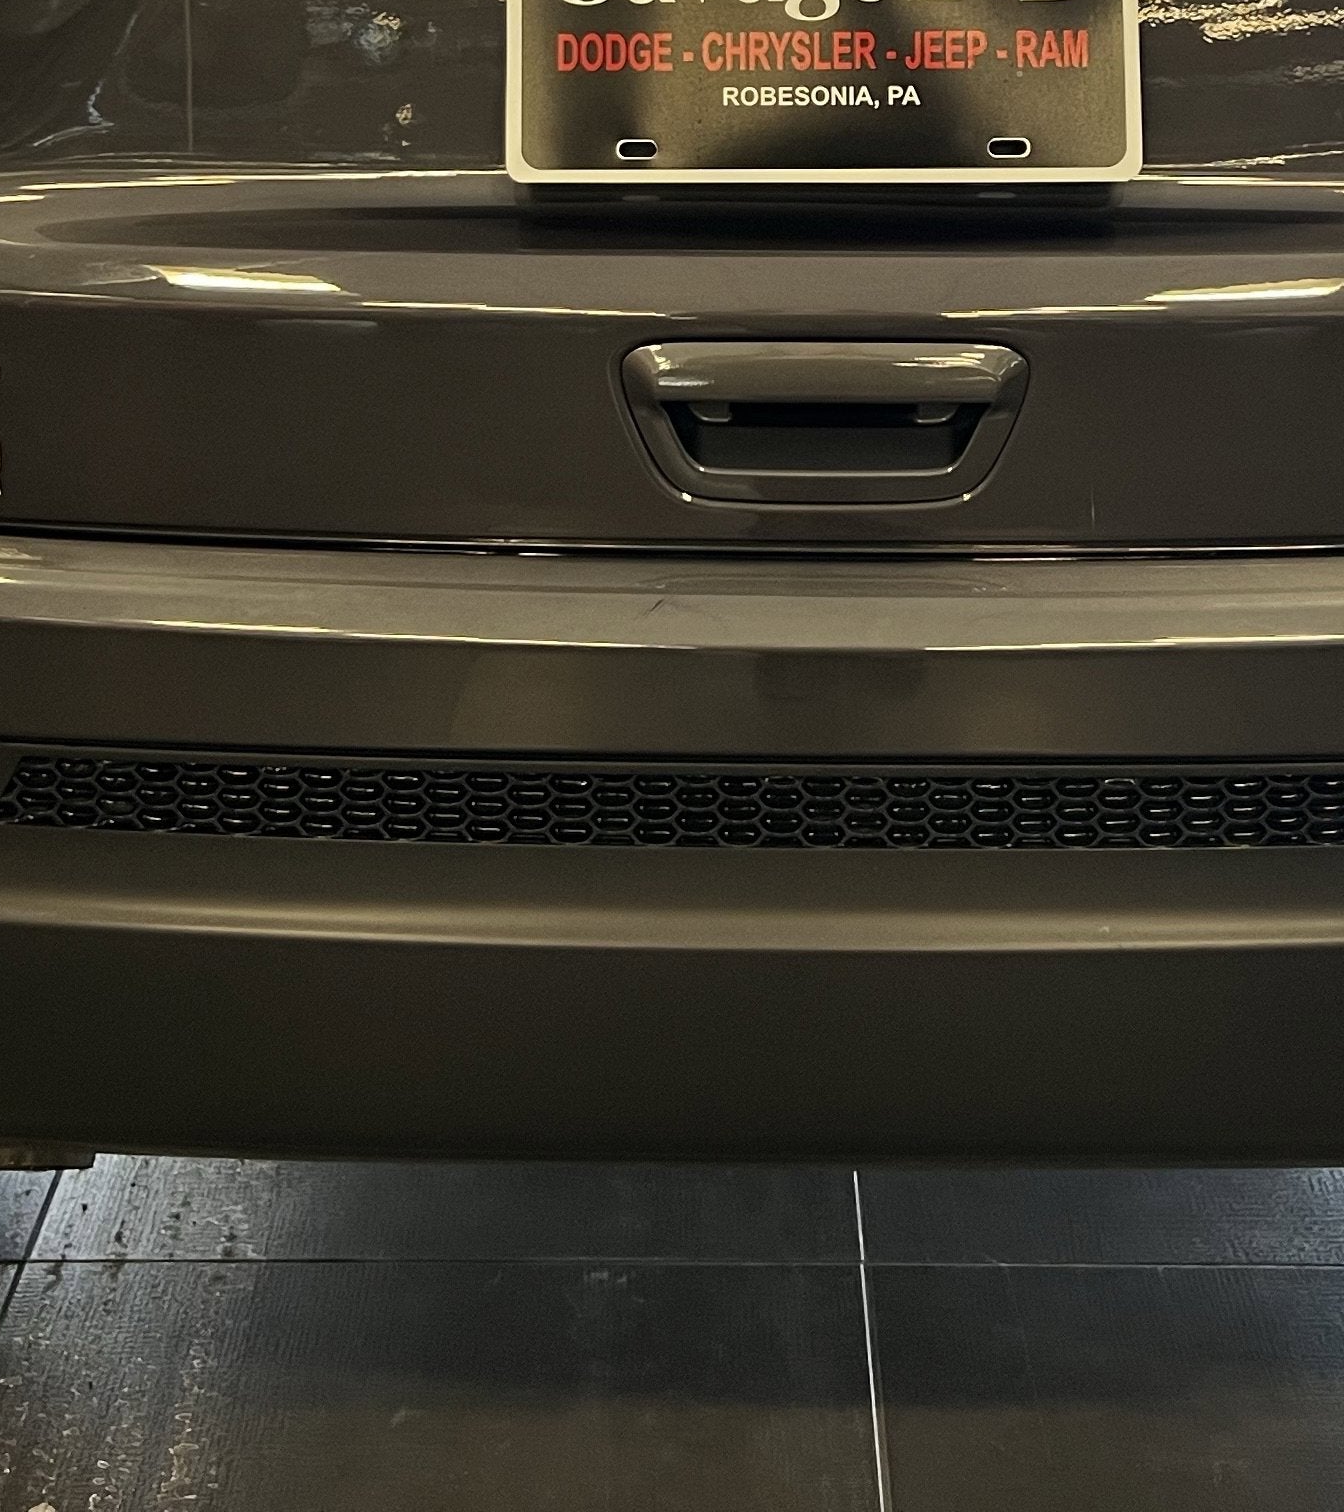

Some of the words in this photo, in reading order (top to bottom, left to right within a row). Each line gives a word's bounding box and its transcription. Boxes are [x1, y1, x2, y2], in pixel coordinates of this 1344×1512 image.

[556, 31, 674, 72] DODGE
[702, 30, 876, 71] CHRYSLER
[904, 29, 988, 69] JEEP
[1016, 28, 1090, 69] RAM
[722, 86, 880, 109] ROBESONIA,
[888, 86, 921, 105] PA
